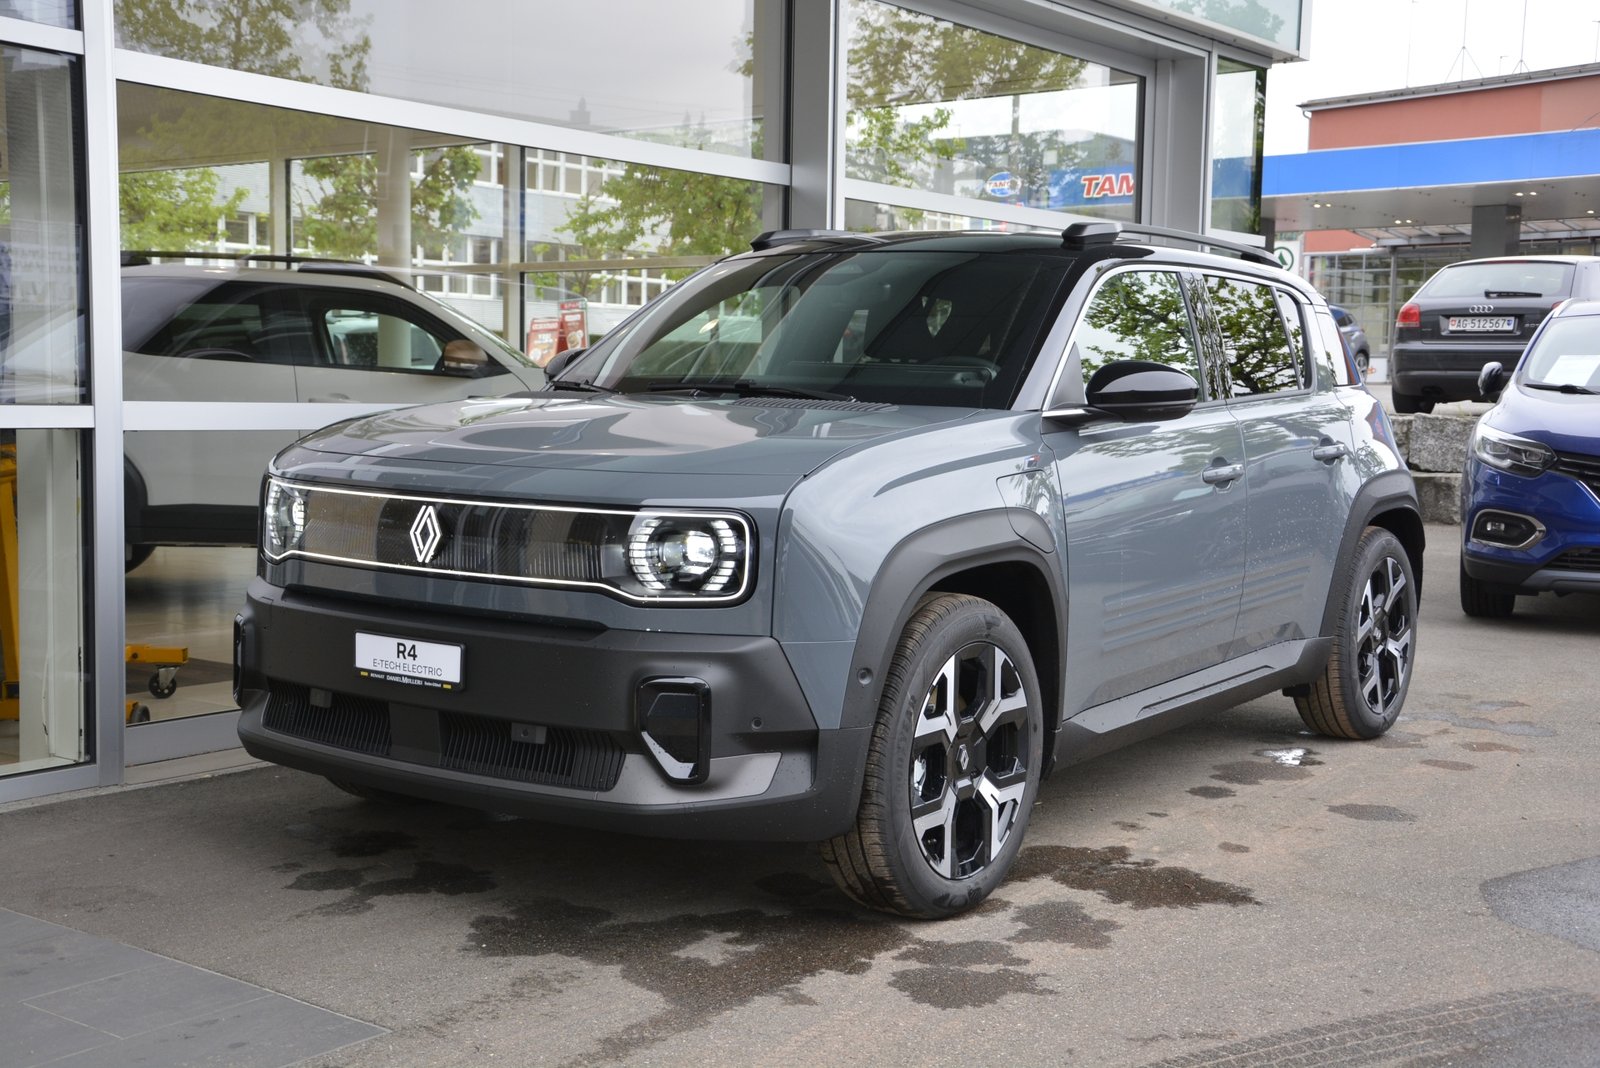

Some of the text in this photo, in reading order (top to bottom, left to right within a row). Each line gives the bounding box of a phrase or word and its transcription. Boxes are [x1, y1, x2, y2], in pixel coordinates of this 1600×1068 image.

[396, 642, 418, 661] R4
[372, 658, 443, 677] E-TECH ELECTRIC
